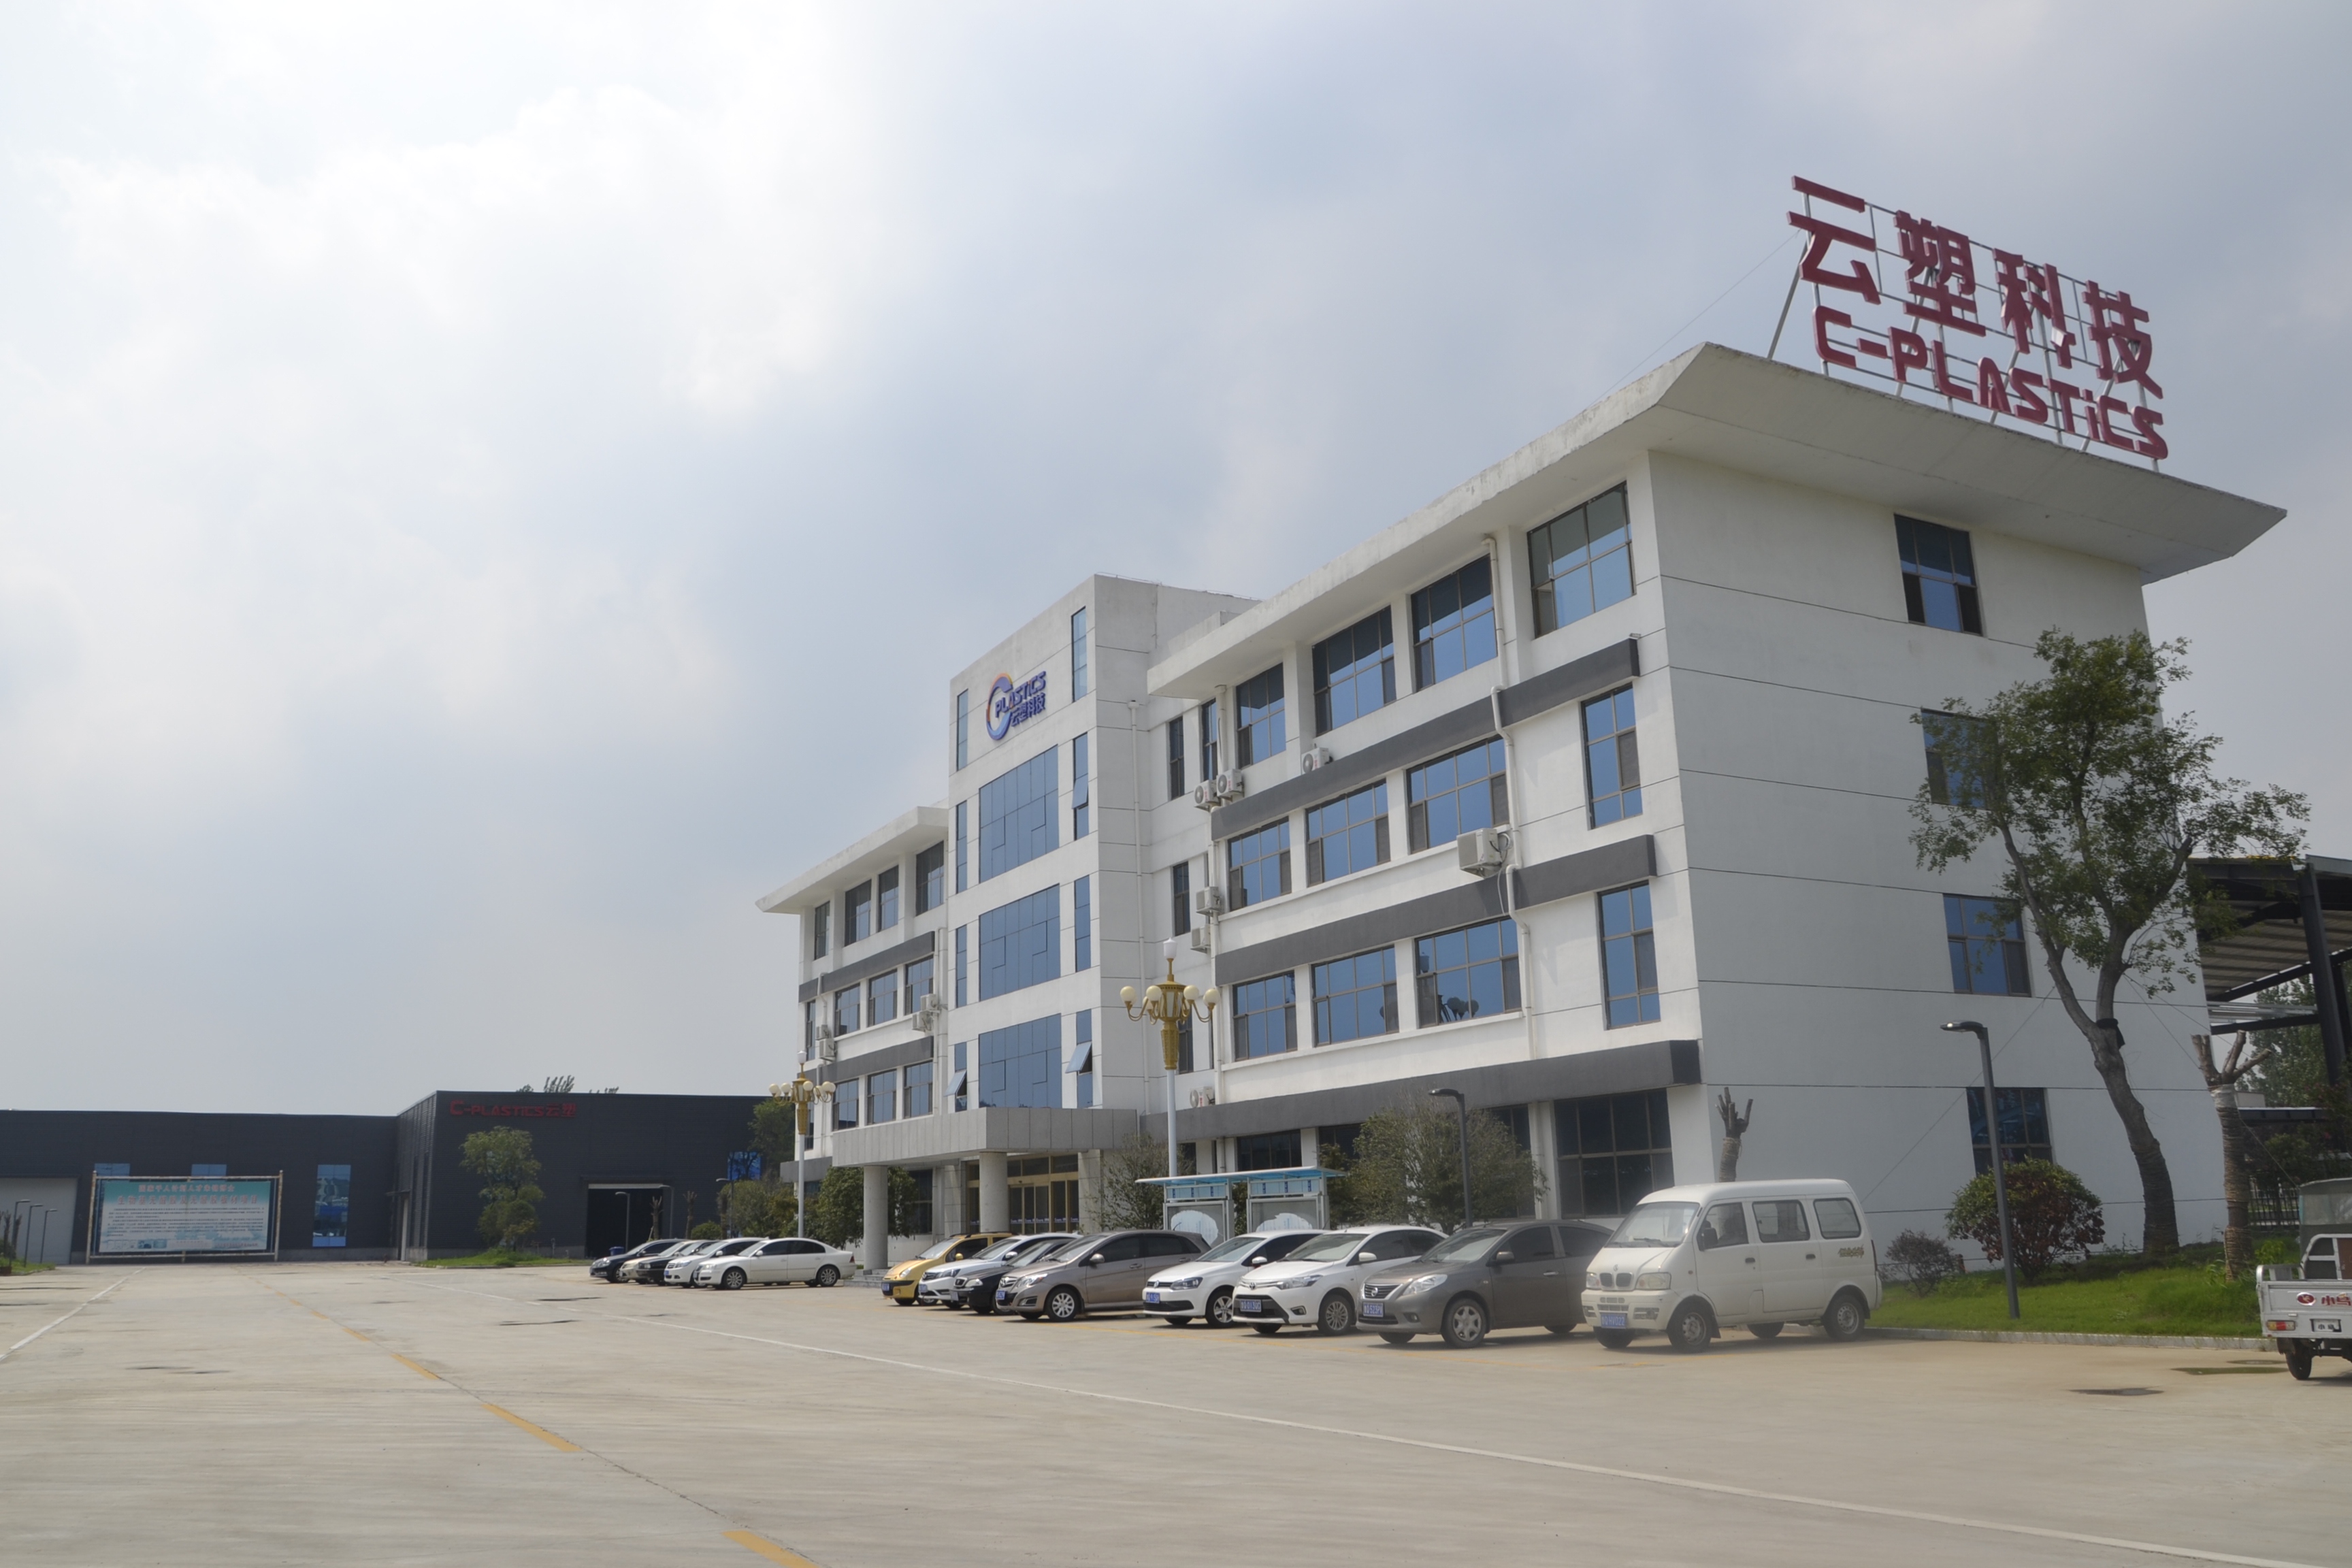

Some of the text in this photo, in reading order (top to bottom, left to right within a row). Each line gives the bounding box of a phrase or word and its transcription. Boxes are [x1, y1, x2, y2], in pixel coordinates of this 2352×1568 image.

[1786, 175, 2163, 399] 云塑科技
[1010, 692, 1046, 727] 云塑科技
[546, 1102, 576, 1117] 云塑
